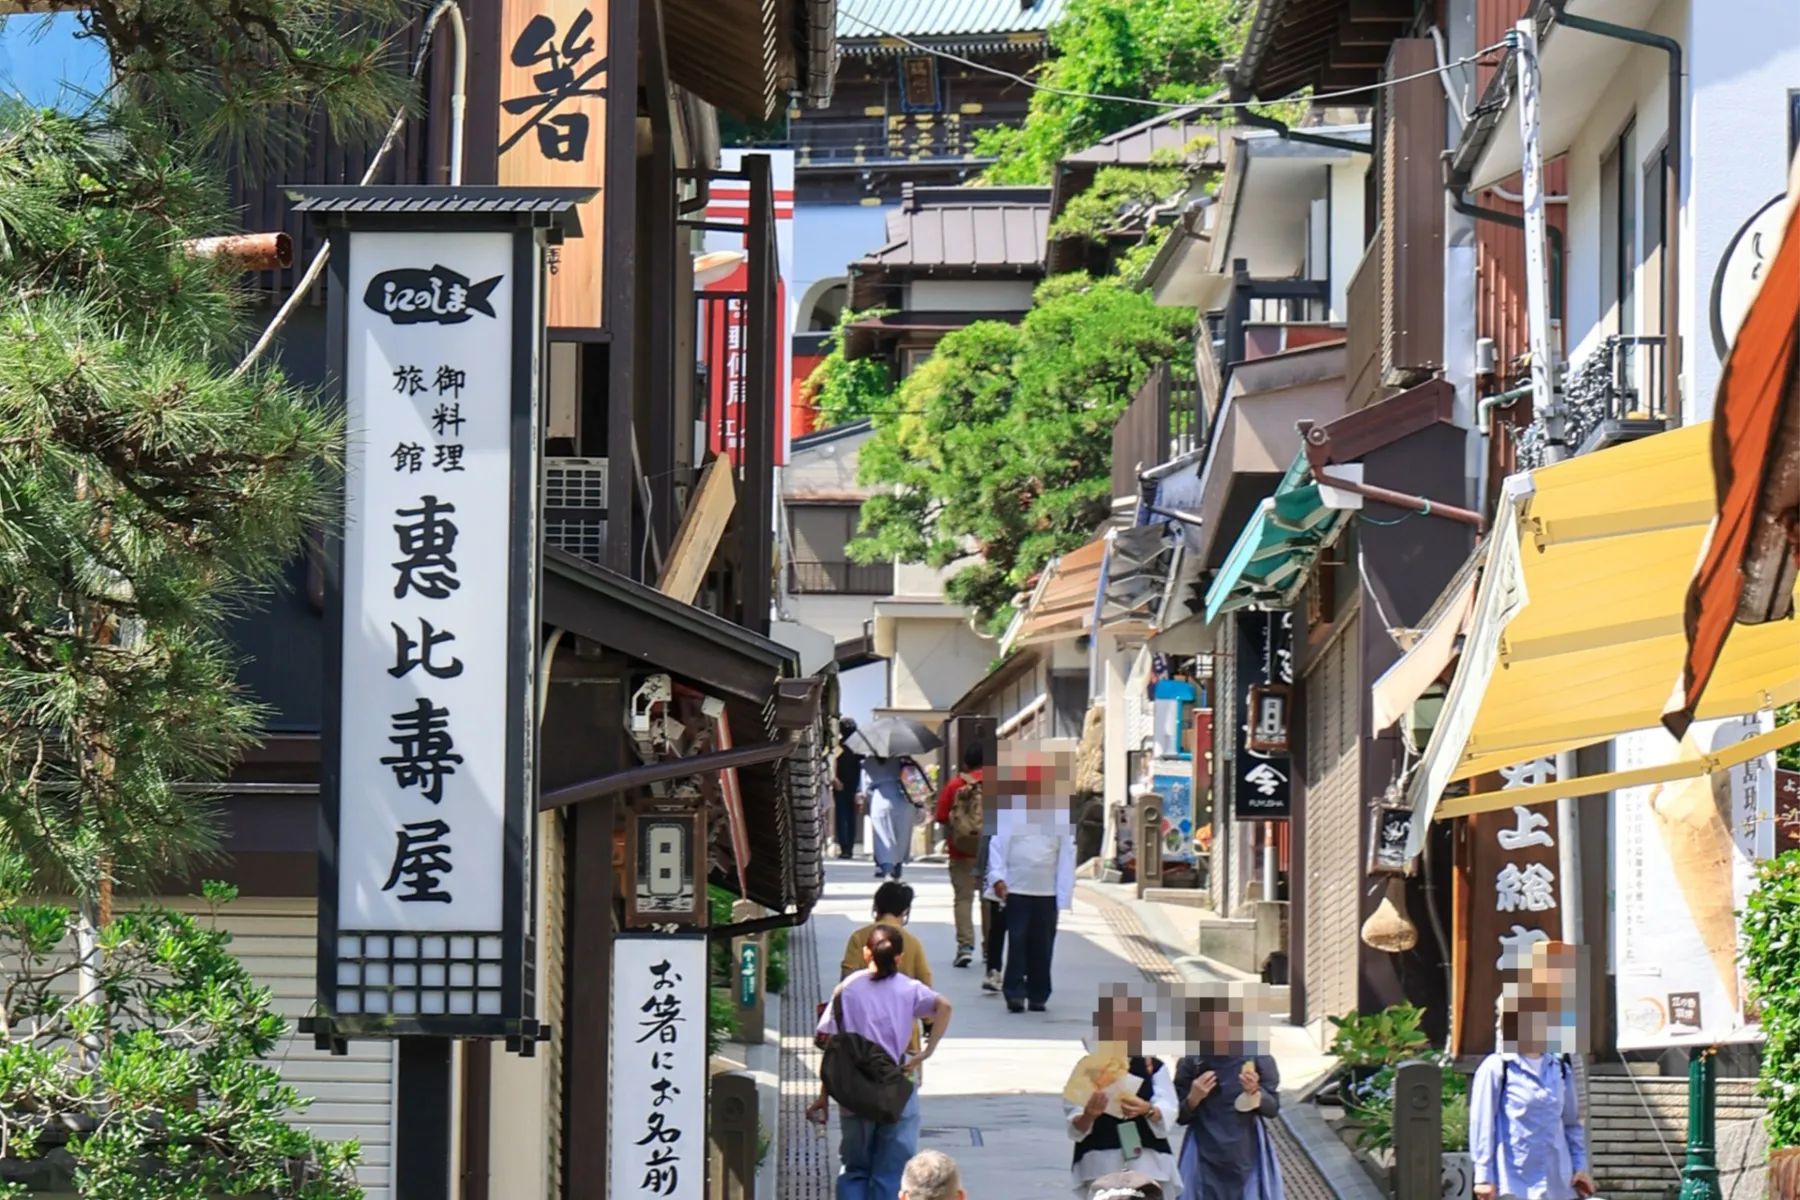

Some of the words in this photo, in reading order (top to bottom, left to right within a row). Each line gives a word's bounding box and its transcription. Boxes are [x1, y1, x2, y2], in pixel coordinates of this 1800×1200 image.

[498, 8, 608, 163] 箸
[390, 364, 428, 474] 旅館
[432, 364, 467, 473] 御料理
[633, 959, 687, 1197] お箸にお名前
